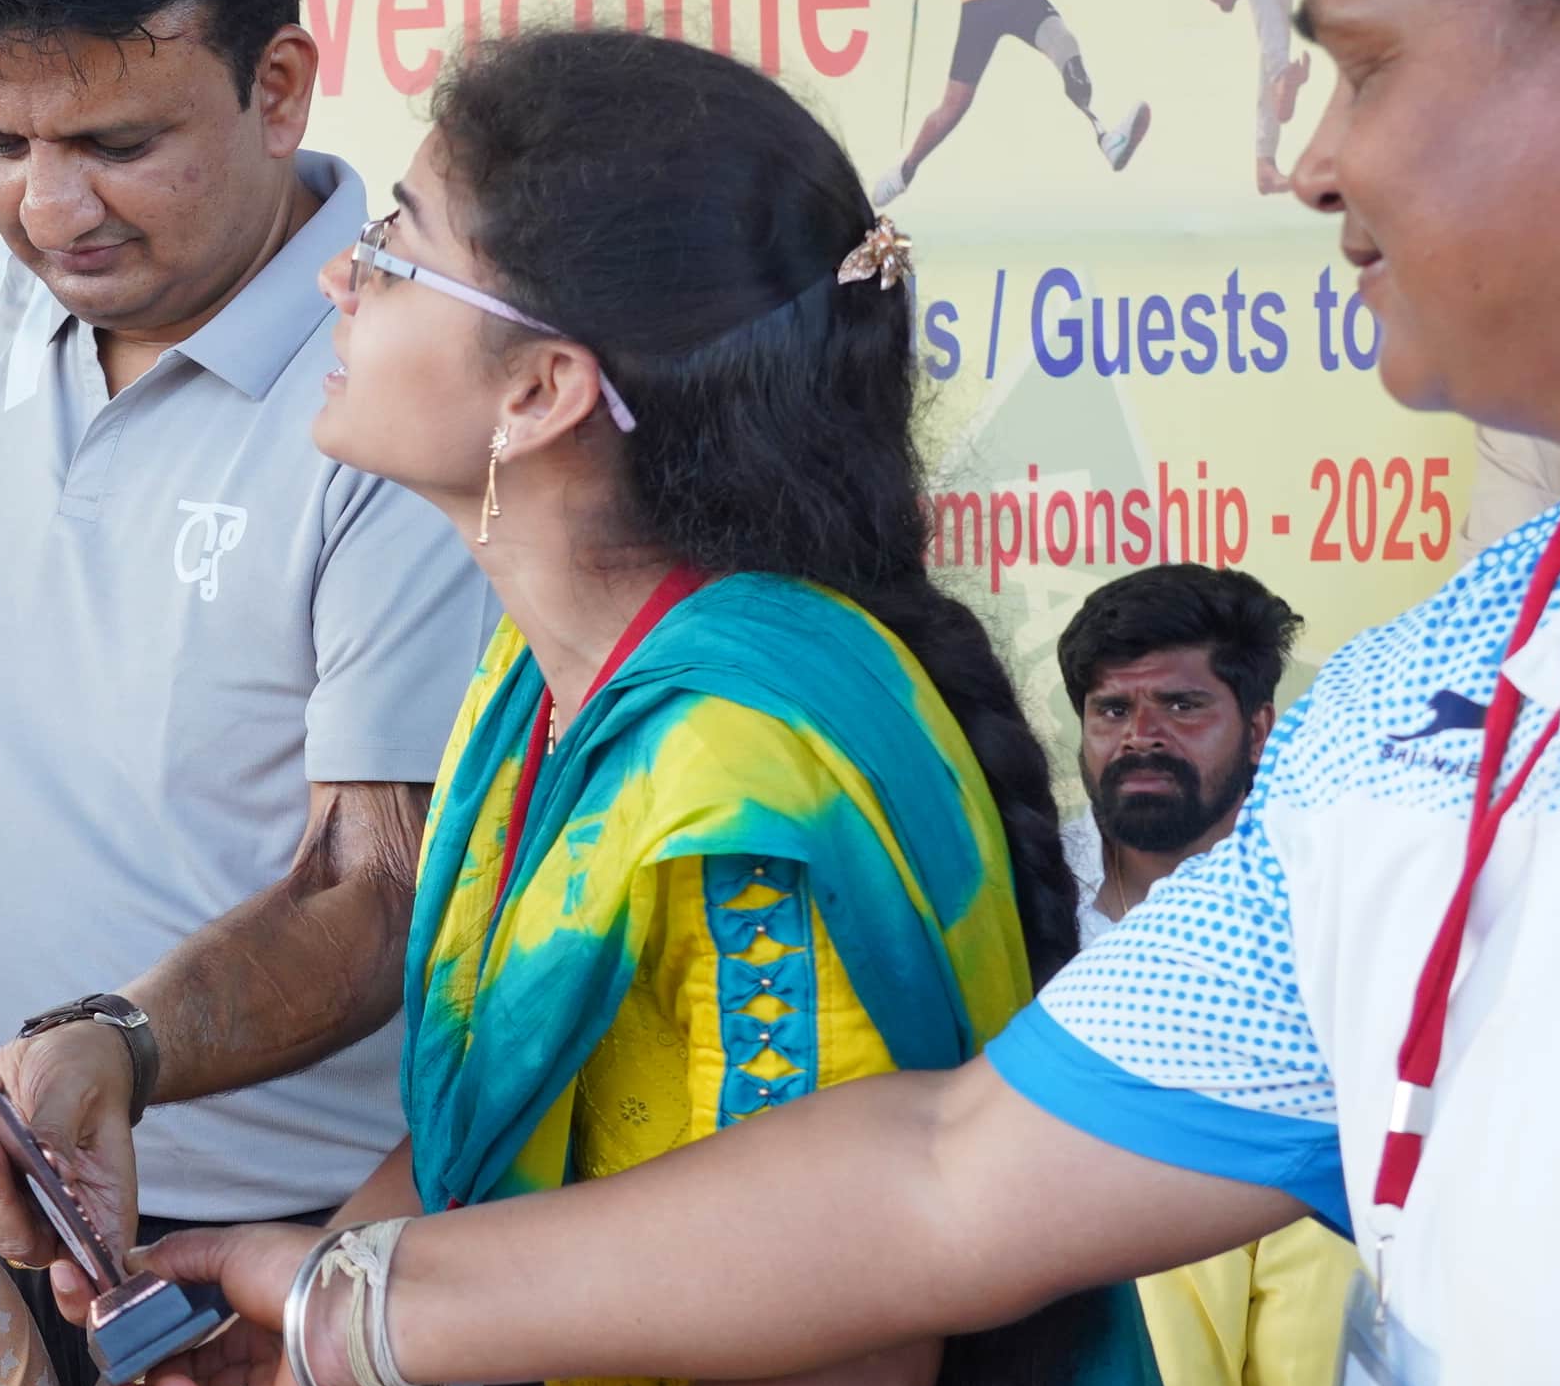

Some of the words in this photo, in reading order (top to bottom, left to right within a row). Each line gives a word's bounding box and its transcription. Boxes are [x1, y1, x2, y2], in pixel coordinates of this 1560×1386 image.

[1030, 265, 1290, 380] Guests
[1313, 263, 1381, 373] to
[918, 459, 1249, 594] mpionship
[1308, 456, 1453, 564] 2025
